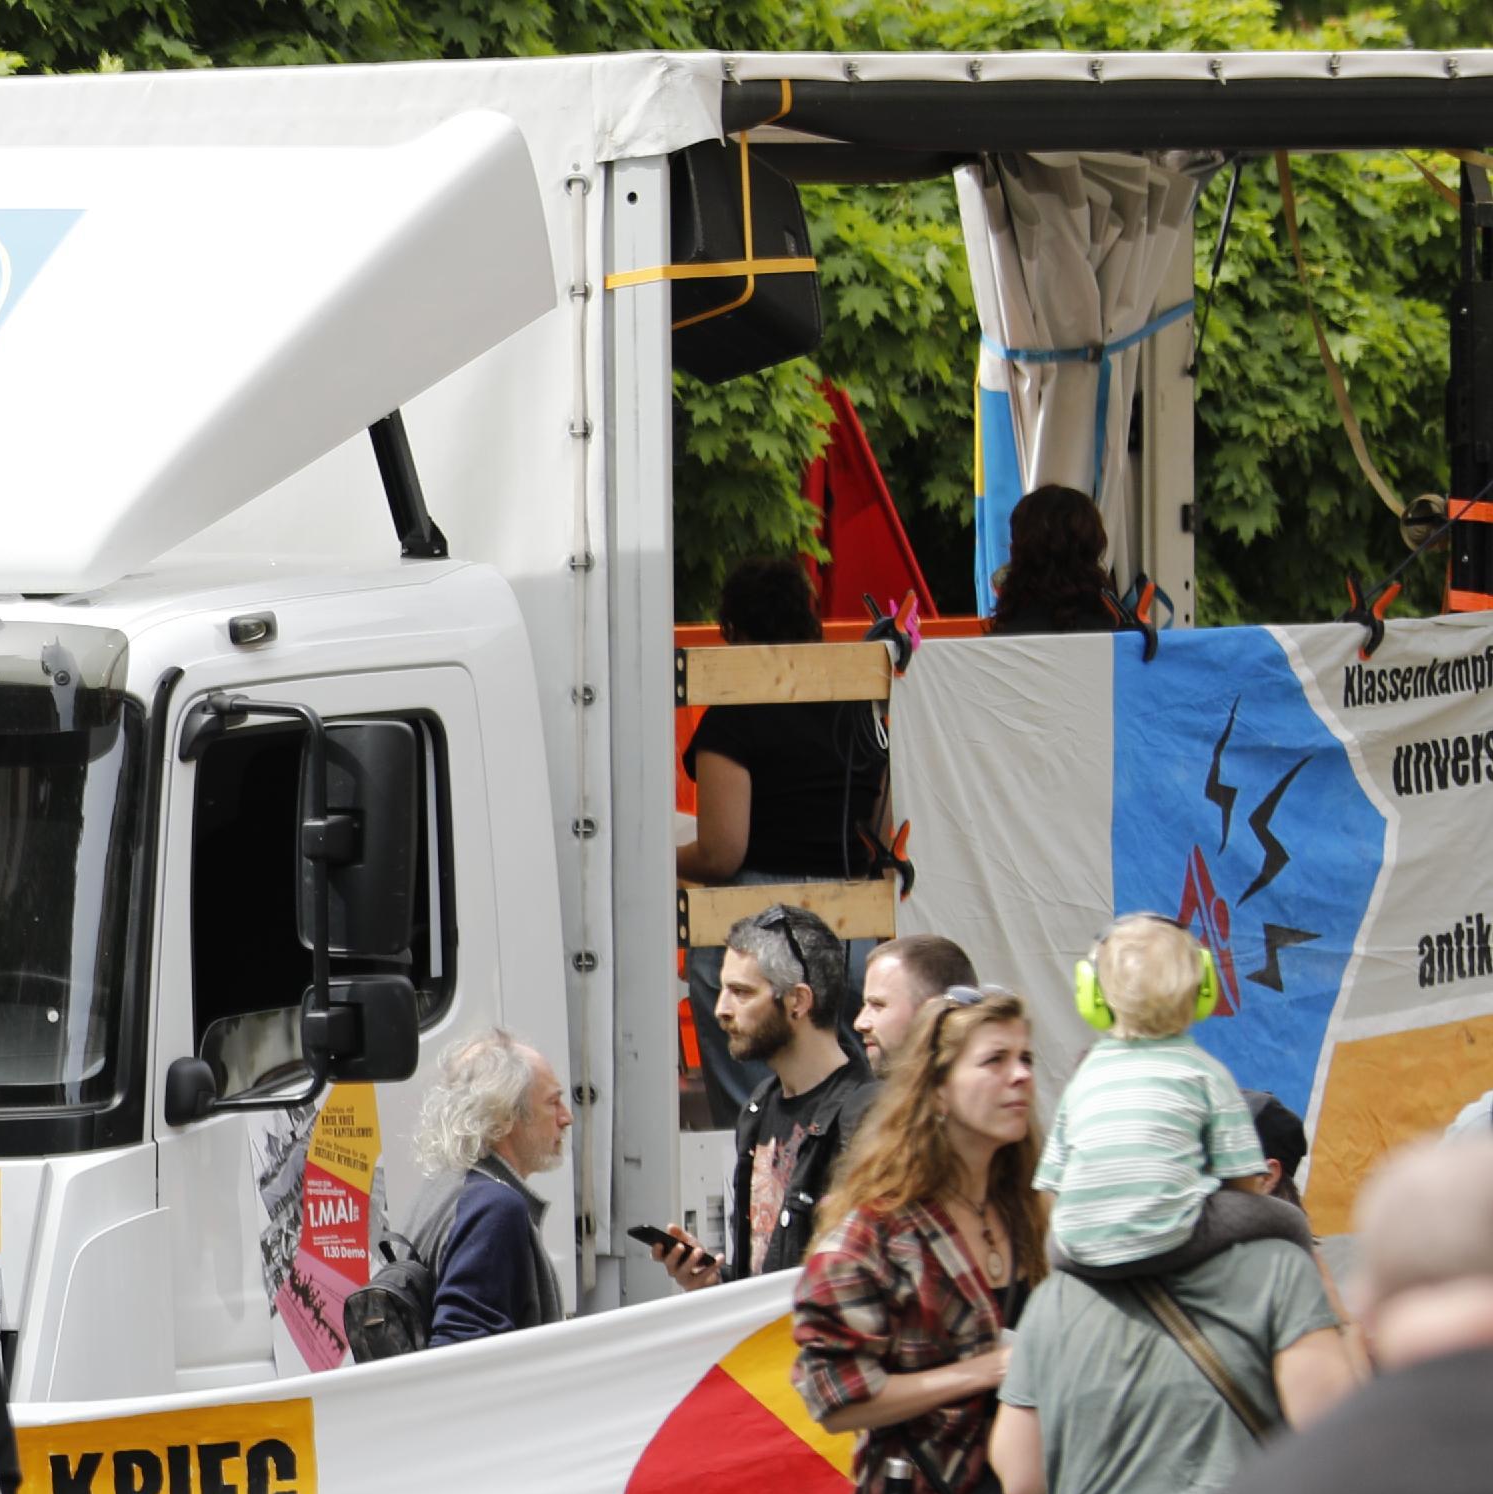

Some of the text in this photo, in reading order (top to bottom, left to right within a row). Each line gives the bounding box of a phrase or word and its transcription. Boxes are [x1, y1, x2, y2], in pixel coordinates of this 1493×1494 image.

[1393, 730, 1493, 797] unvers
[1418, 912, 1493, 989] antik
[307, 1196, 353, 1229] 1.MAI
[341, 1247, 367, 1260] Demo
